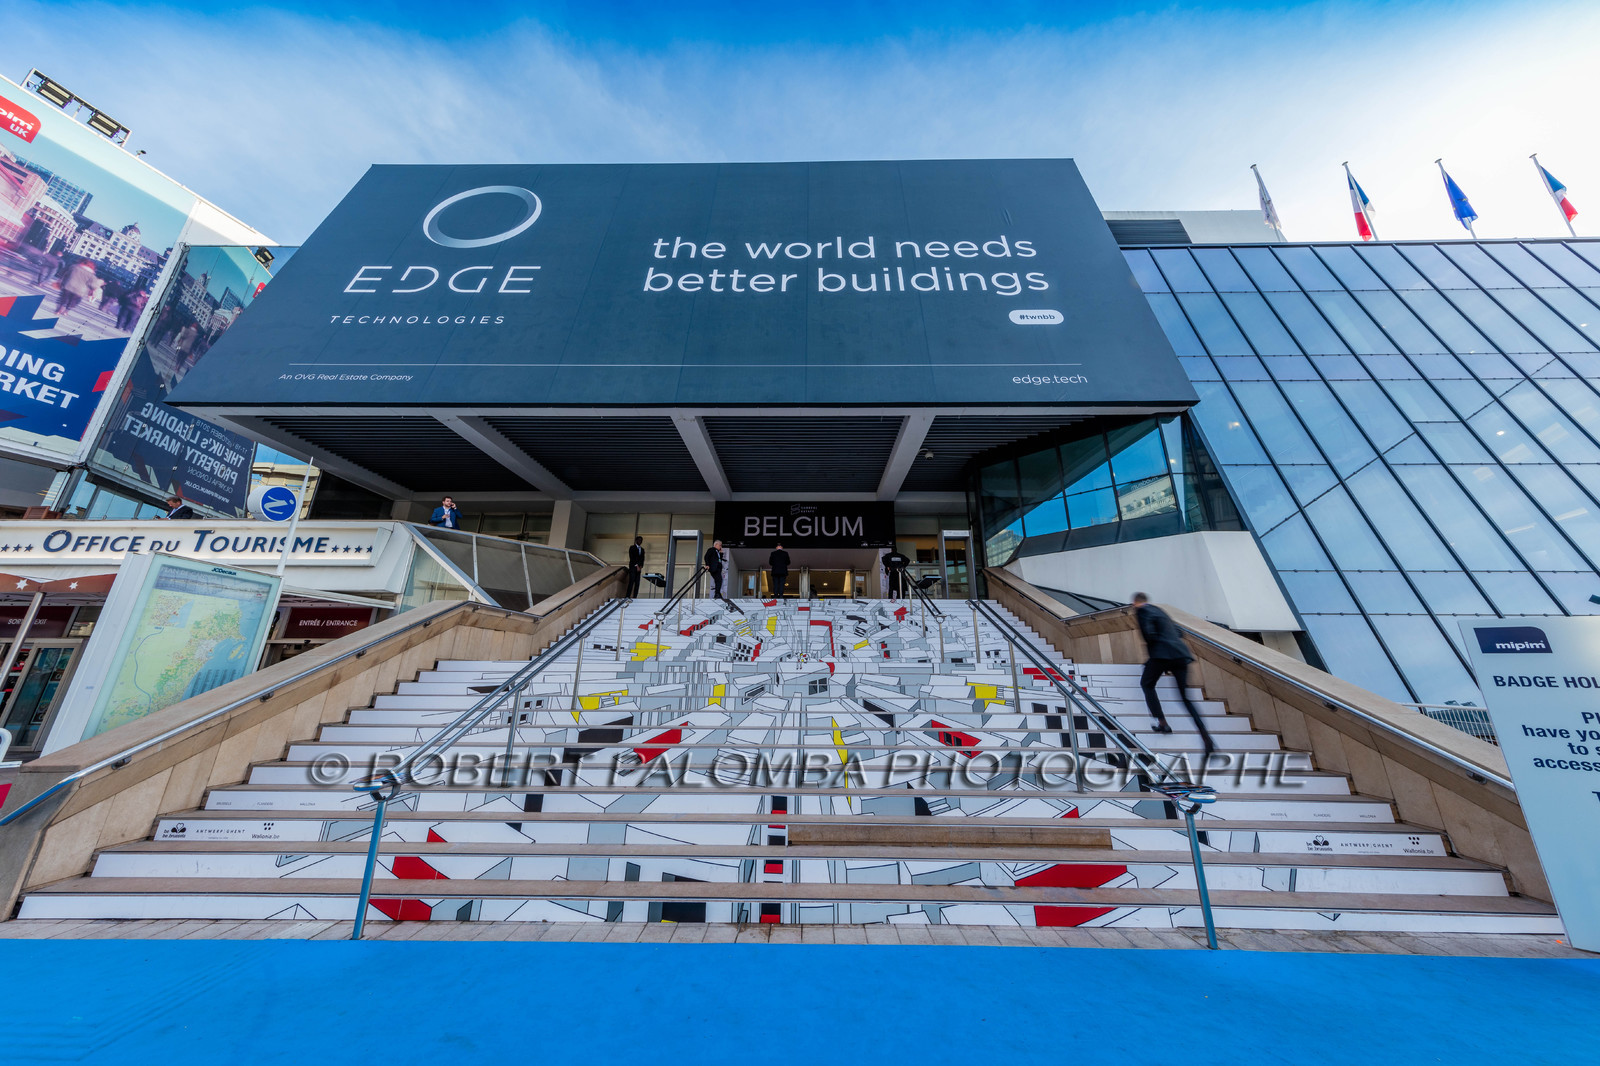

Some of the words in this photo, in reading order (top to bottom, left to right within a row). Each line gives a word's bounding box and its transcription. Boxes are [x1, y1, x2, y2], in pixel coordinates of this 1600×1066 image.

[10, 123, 28, 138] UK
[653, 236, 727, 259] the
[745, 236, 876, 260] world
[894, 235, 1038, 259] needs
[343, 265, 541, 293] EDGE
[643, 267, 797, 292] better
[818, 266, 1049, 296] buildings
[330, 315, 505, 324] TECHNOLOGIES
[294, 373, 316, 381] OVG
[316, 373, 339, 381] Real
[339, 373, 368, 381] Estate
[369, 373, 414, 382] Company
[1012, 374, 1089, 386] edge.tech
[743, 516, 864, 537] BELGIUM
[42, 529, 145, 553] OFFICE
[149, 539, 181, 553] DU
[326, 619, 358, 627] ENTRANCE
[1495, 639, 1547, 651] mipim
[1492, 675, 1560, 688] BADGE
[1521, 724, 1571, 739] have
[1567, 742, 1589, 756] to
